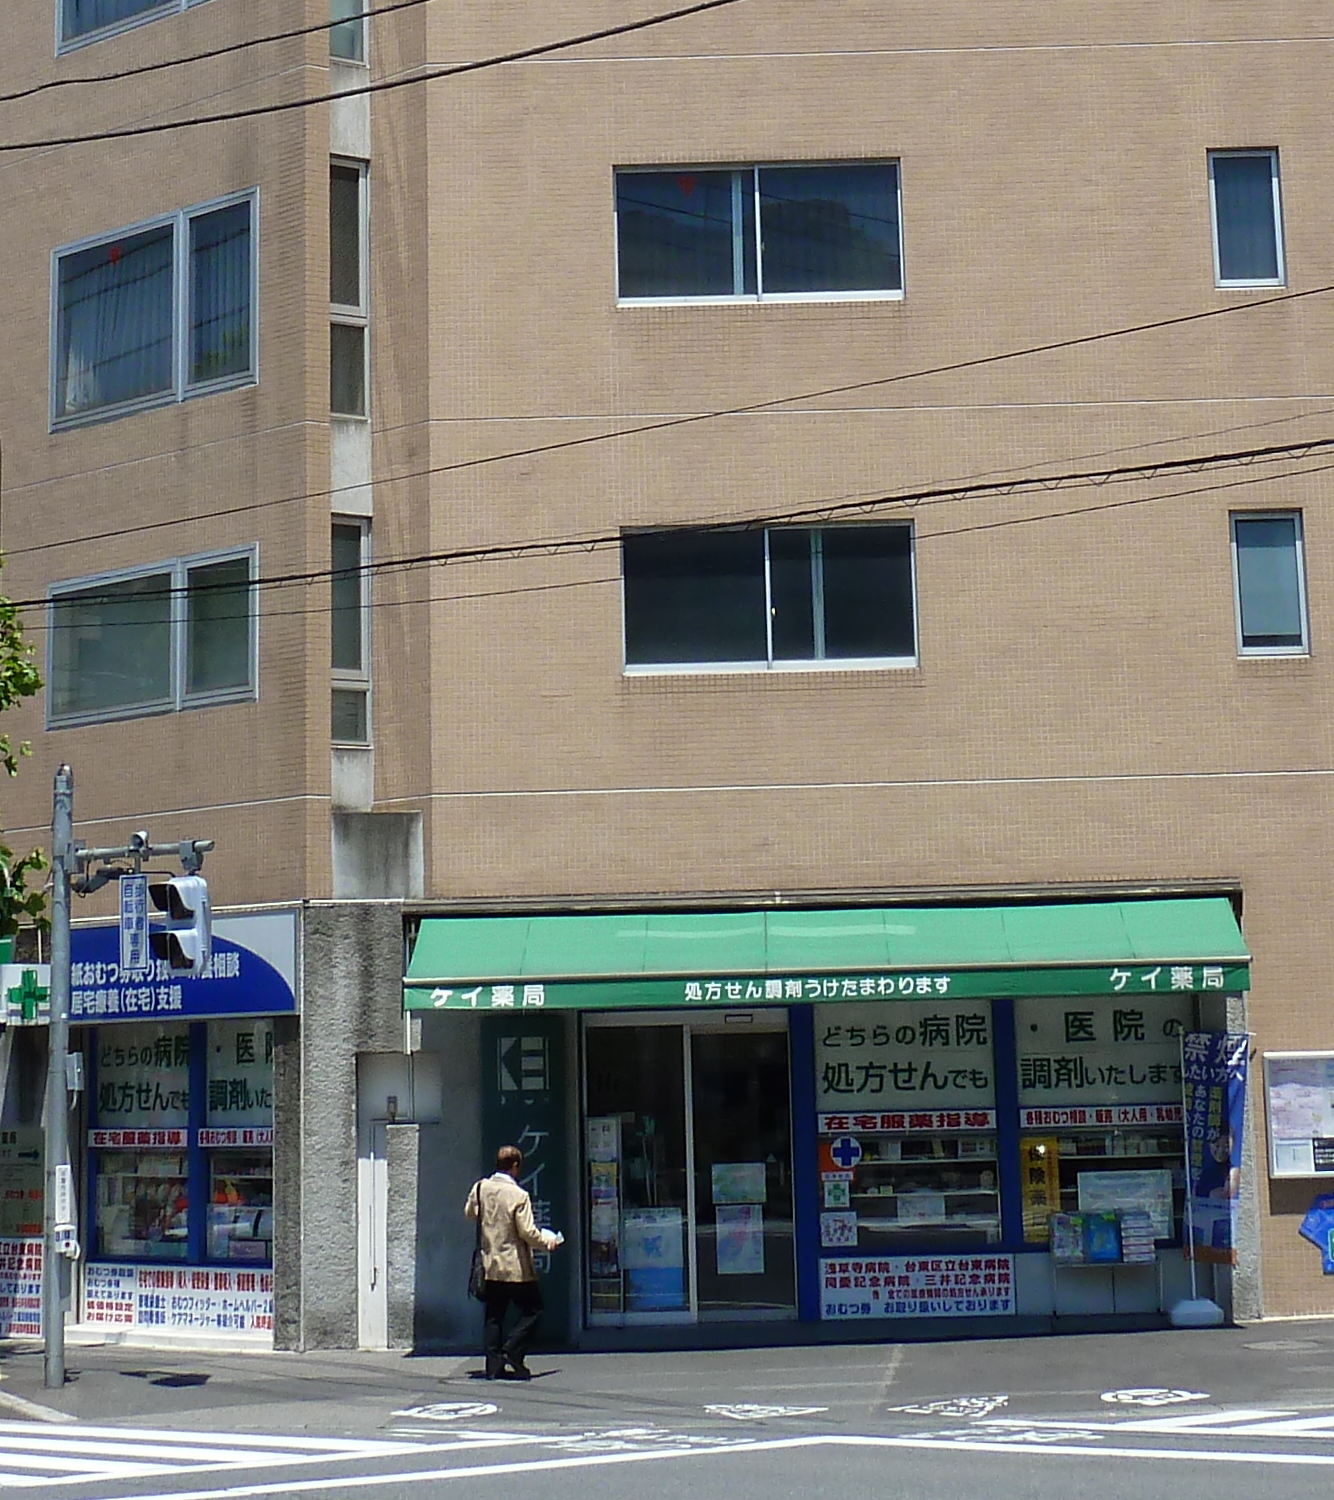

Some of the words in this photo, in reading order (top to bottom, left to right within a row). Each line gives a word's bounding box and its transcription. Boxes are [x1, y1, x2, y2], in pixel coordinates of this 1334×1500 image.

[684, 976, 952, 1002] 処方せん調剤うけたまわります
[1108, 966, 1226, 991] ケイ薬局
[429, 984, 546, 1008] ケイ薬局
[822, 1012, 989, 1047] どちらの病院
[821, 1060, 989, 1095] 処方せんでも
[824, 1112, 991, 1131] 在宅服薬指導
